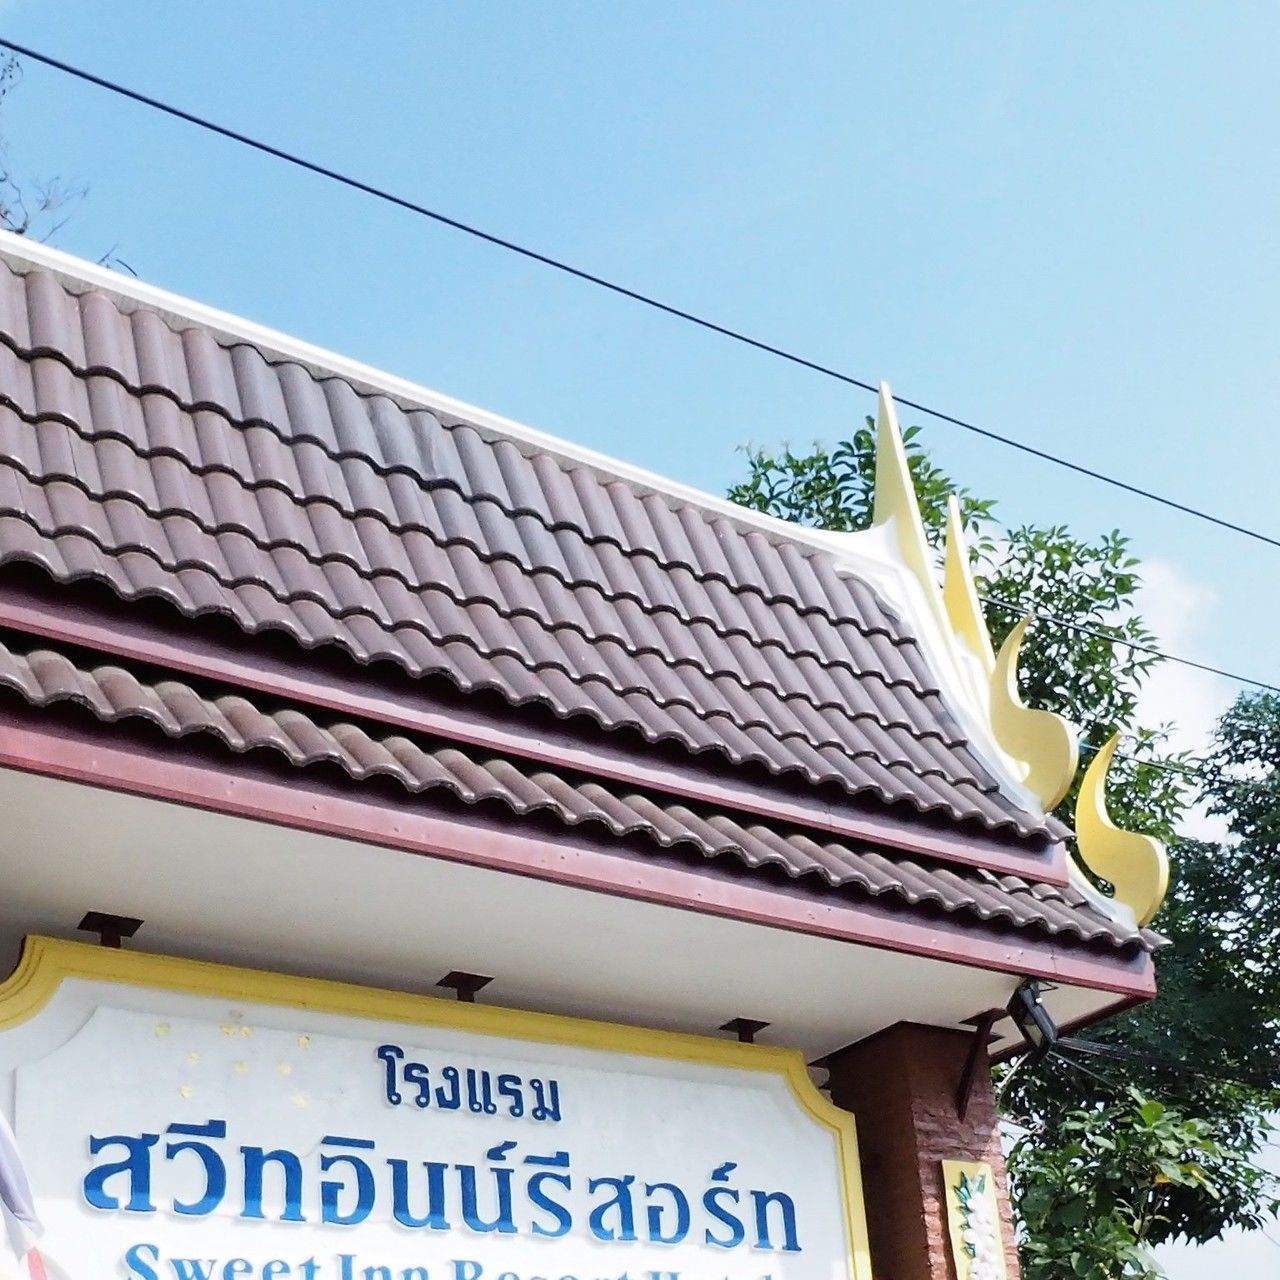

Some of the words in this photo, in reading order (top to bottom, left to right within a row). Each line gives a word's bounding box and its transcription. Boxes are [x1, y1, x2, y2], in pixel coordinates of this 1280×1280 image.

[375, 1043, 563, 1123] โรงแรม
[82, 1118, 803, 1254] สวีทอินน์รีสอร์ท
